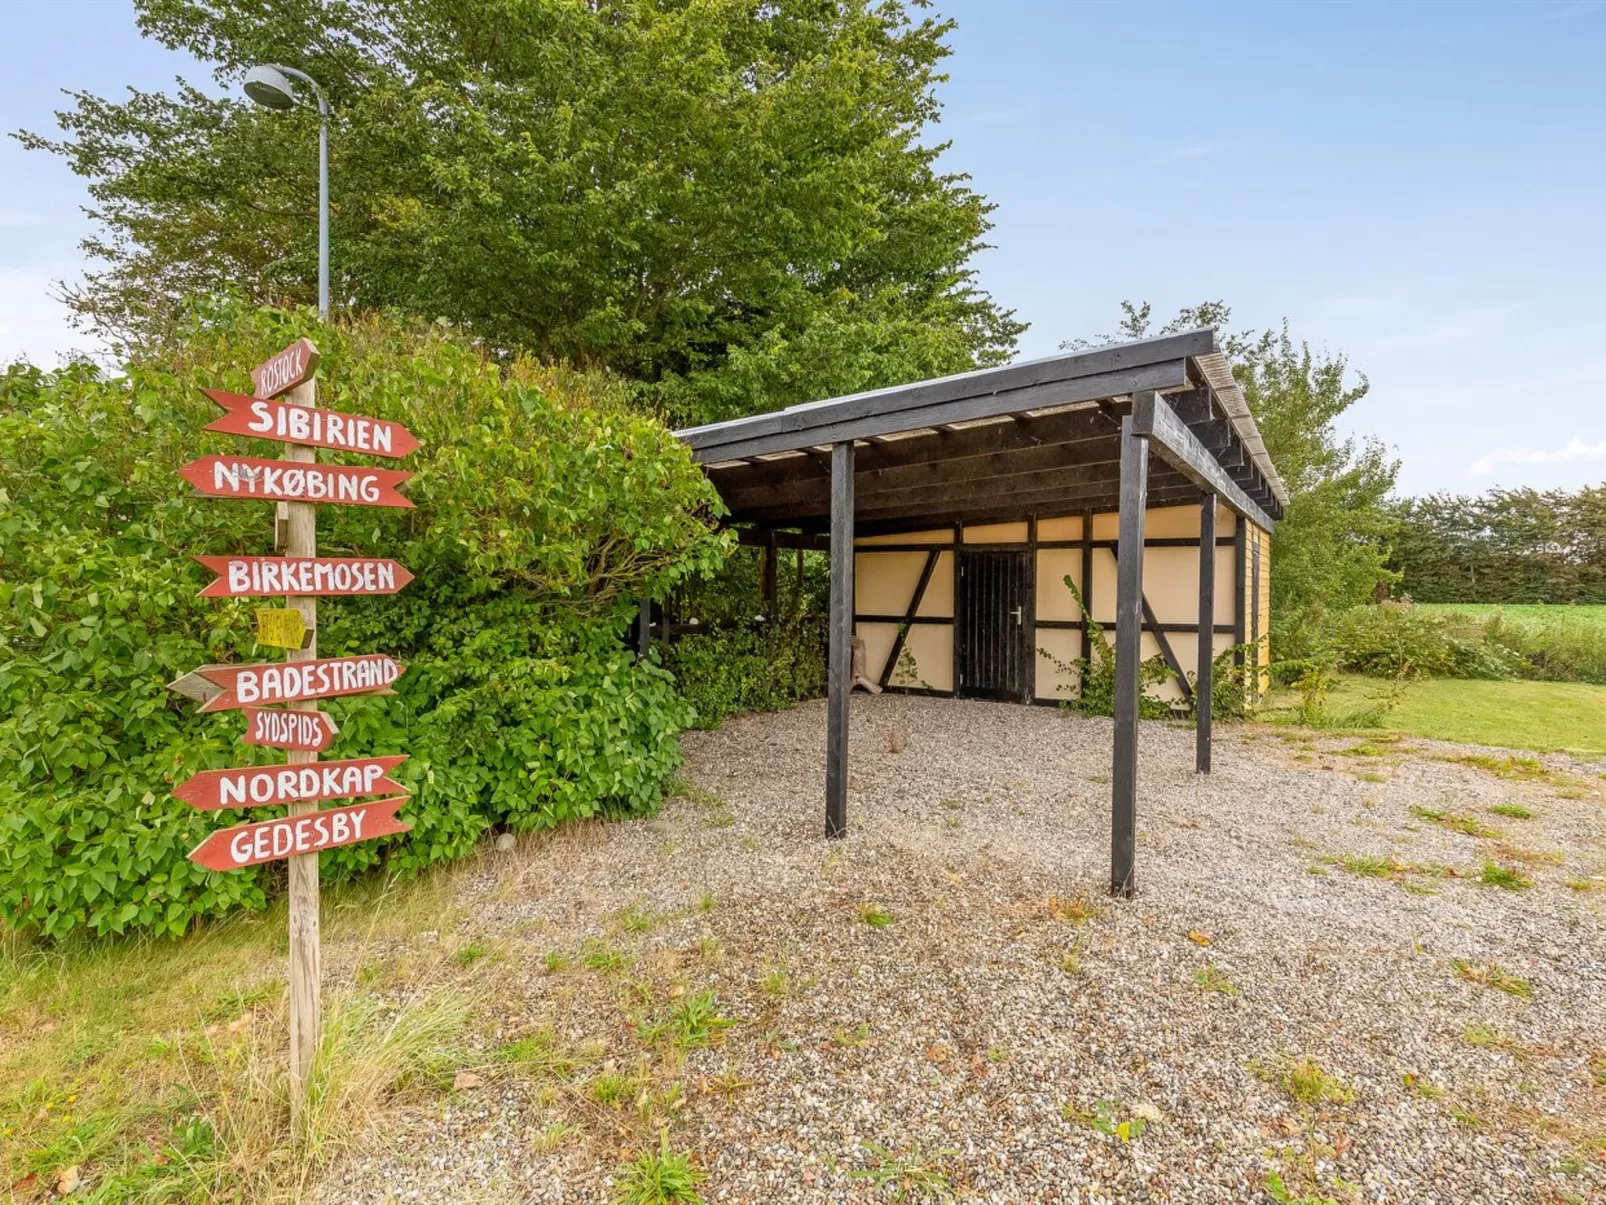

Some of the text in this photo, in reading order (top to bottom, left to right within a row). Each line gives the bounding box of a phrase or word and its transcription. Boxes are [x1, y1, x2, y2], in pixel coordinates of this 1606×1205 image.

[260, 347, 303, 397] ROSTOCK
[248, 402, 392, 452] SIBIRIEN
[214, 461, 380, 502] NYKØBING
[228, 560, 395, 593] BIRKEMOSEN
[237, 658, 398, 703] BADESTRAND
[255, 711, 323, 746] SYDSPIDS
[219, 765, 384, 805] NORDKAP
[230, 809, 367, 863] GEDESBY
